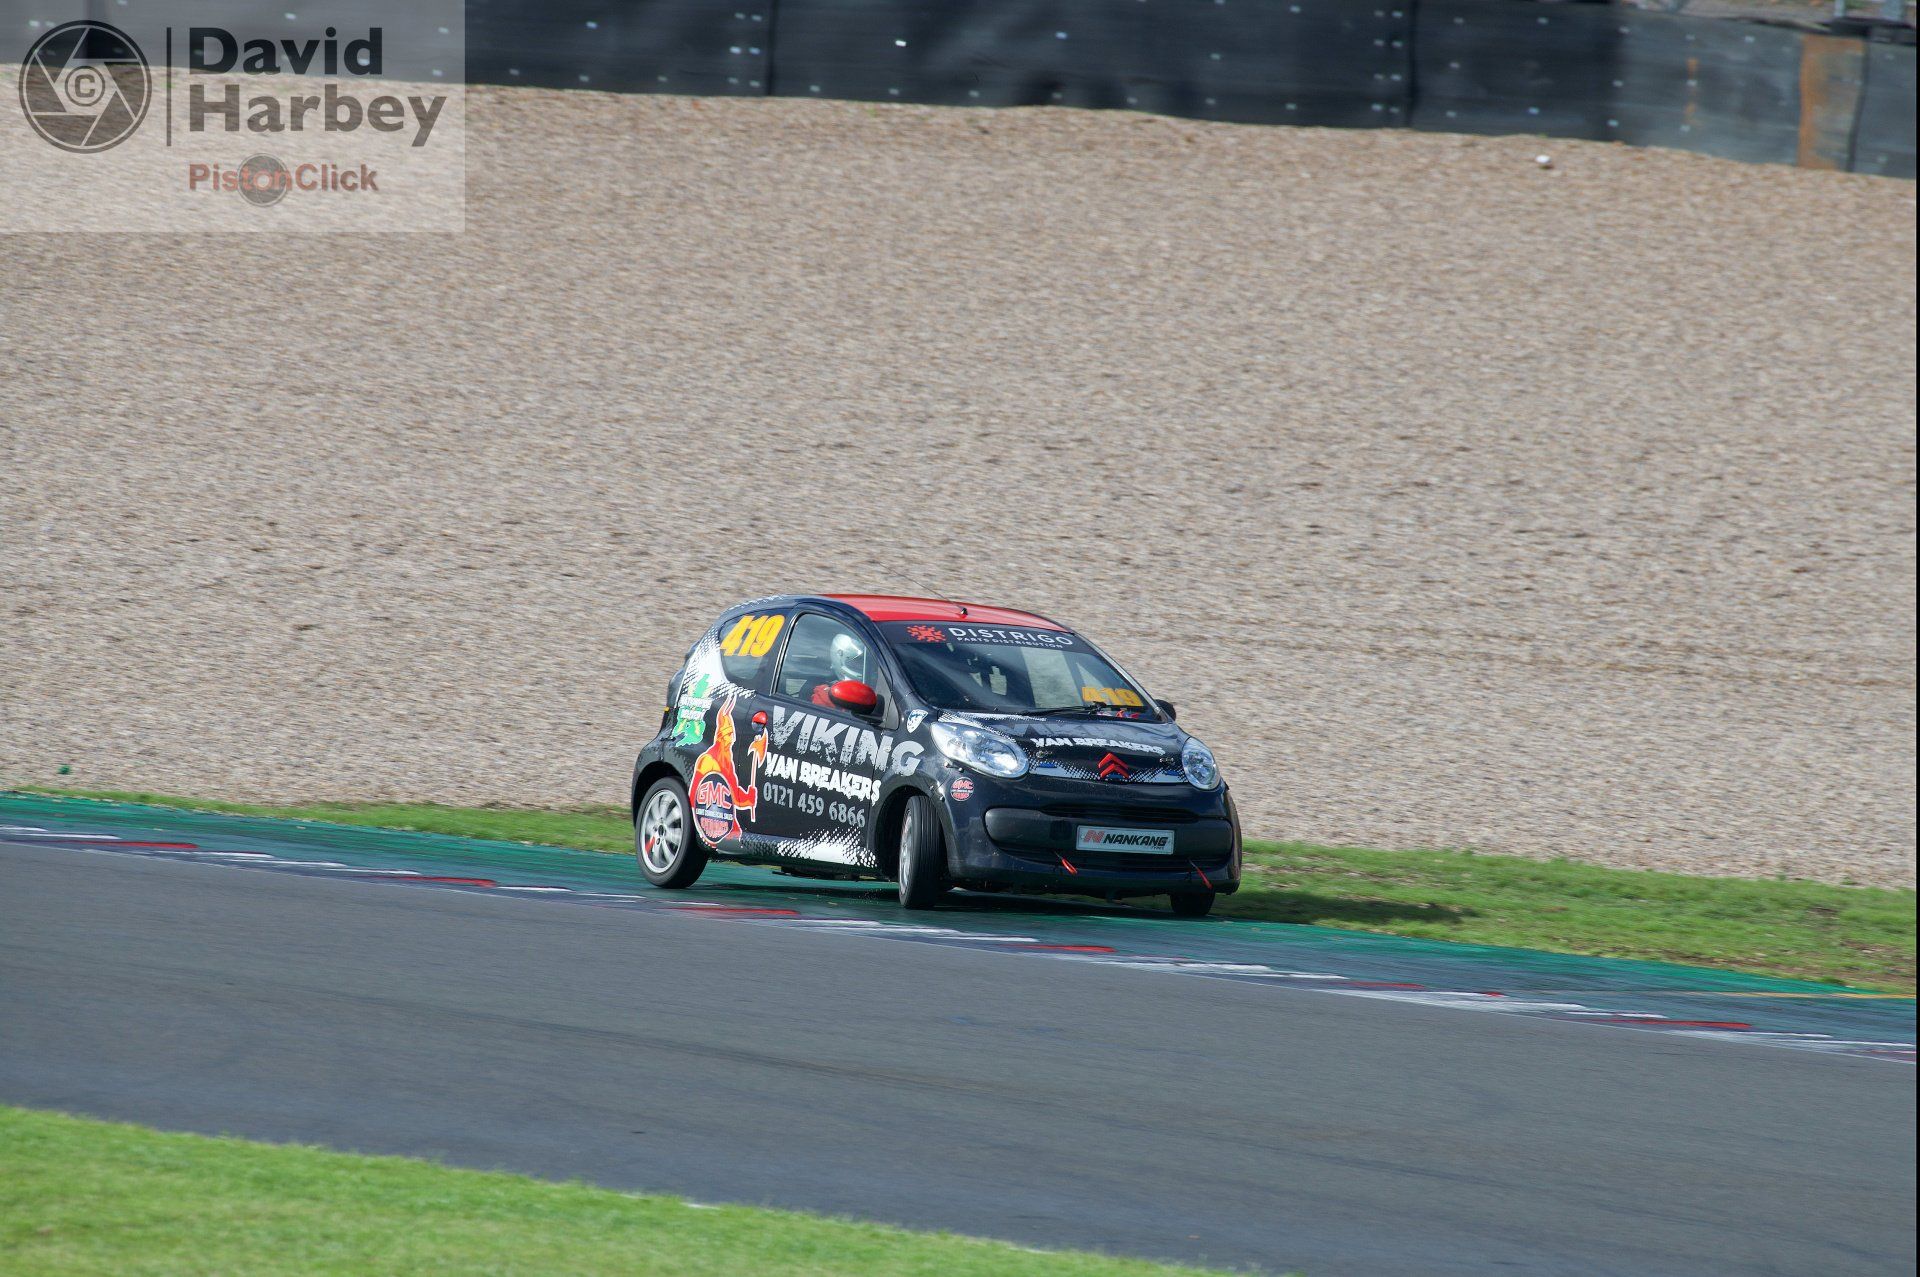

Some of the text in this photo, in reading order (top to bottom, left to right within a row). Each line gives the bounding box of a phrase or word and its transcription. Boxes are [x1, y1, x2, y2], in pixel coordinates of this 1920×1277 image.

[720, 614, 785, 657] 419
[948, 627, 1074, 646] DISTRIGO
[992, 638, 1064, 649] DISTRIBUTION
[1081, 687, 1144, 707] 419
[770, 705, 925, 777] VIKING
[1030, 737, 1166, 756] VAN BREAKERS
[765, 751, 882, 807] VAN BREAKERS
[697, 780, 733, 810] GMC
[763, 782, 866, 828] 0121 459 6866
[1103, 833, 1169, 847] NANKANG
